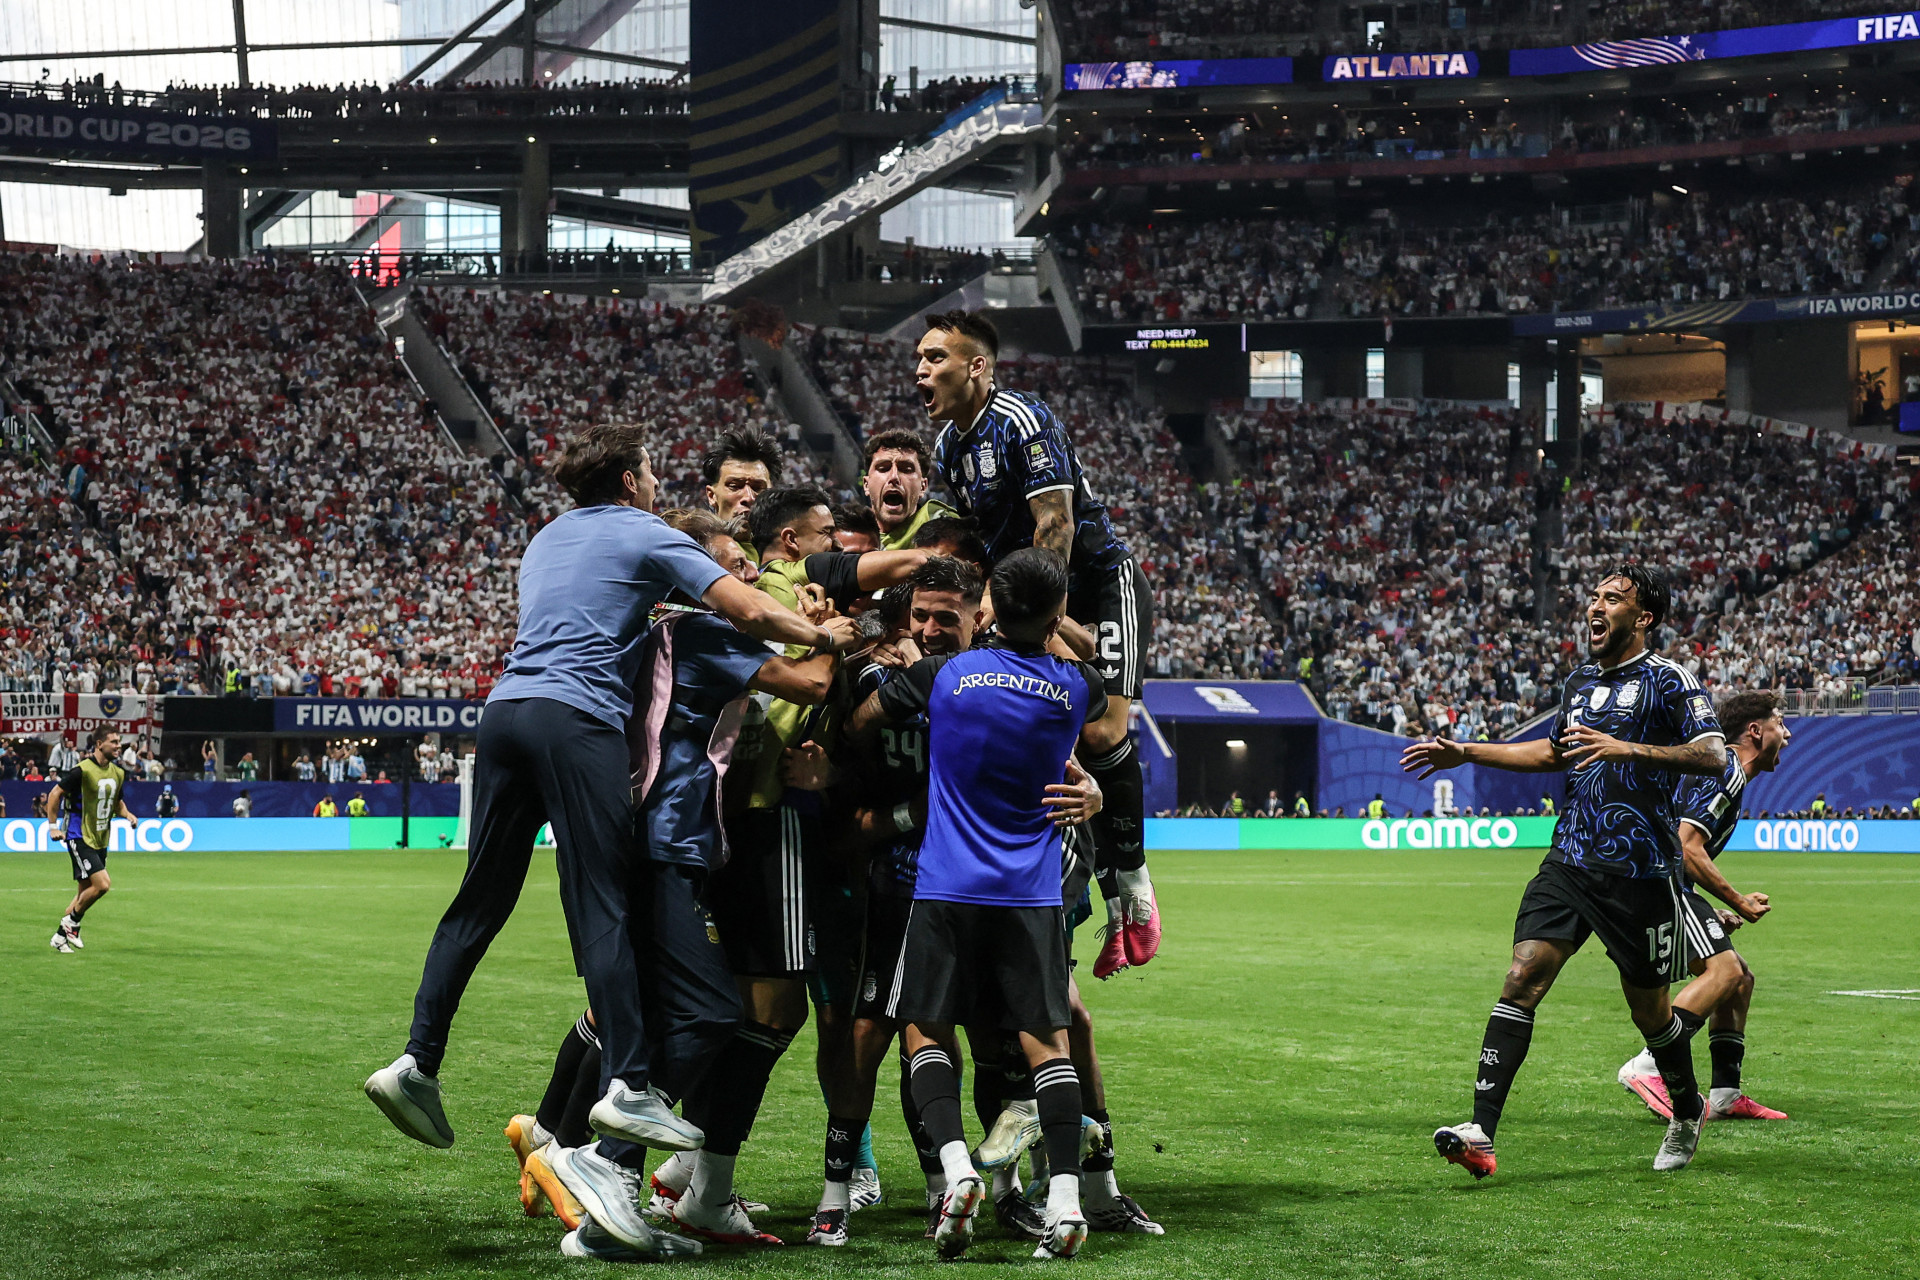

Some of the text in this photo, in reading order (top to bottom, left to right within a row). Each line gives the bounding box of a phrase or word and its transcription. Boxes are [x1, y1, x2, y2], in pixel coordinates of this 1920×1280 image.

[1857, 14, 1920, 42] FIFA
[1331, 53, 1470, 79] ATLANTA
[79, 117, 140, 143] CUP
[146, 121, 251, 150] 2026
[1840, 294, 1908, 312] WORLD
[1125, 339, 1150, 350] TEXT
[1136, 328, 1197, 339] NEED HELP?
[10, 694, 51, 705] BARRY
[953, 672, 1073, 710] ARGENTINA
[3, 704, 60, 717] SHOTTON
[296, 704, 354, 727] FIFA
[358, 705, 456, 728] WORLD
[880, 728, 923, 773] 24
[3, 819, 194, 852] armco
[1361, 818, 1518, 849] aramco
[1754, 820, 1860, 851] aramco
[1646, 921, 1673, 962] 15
